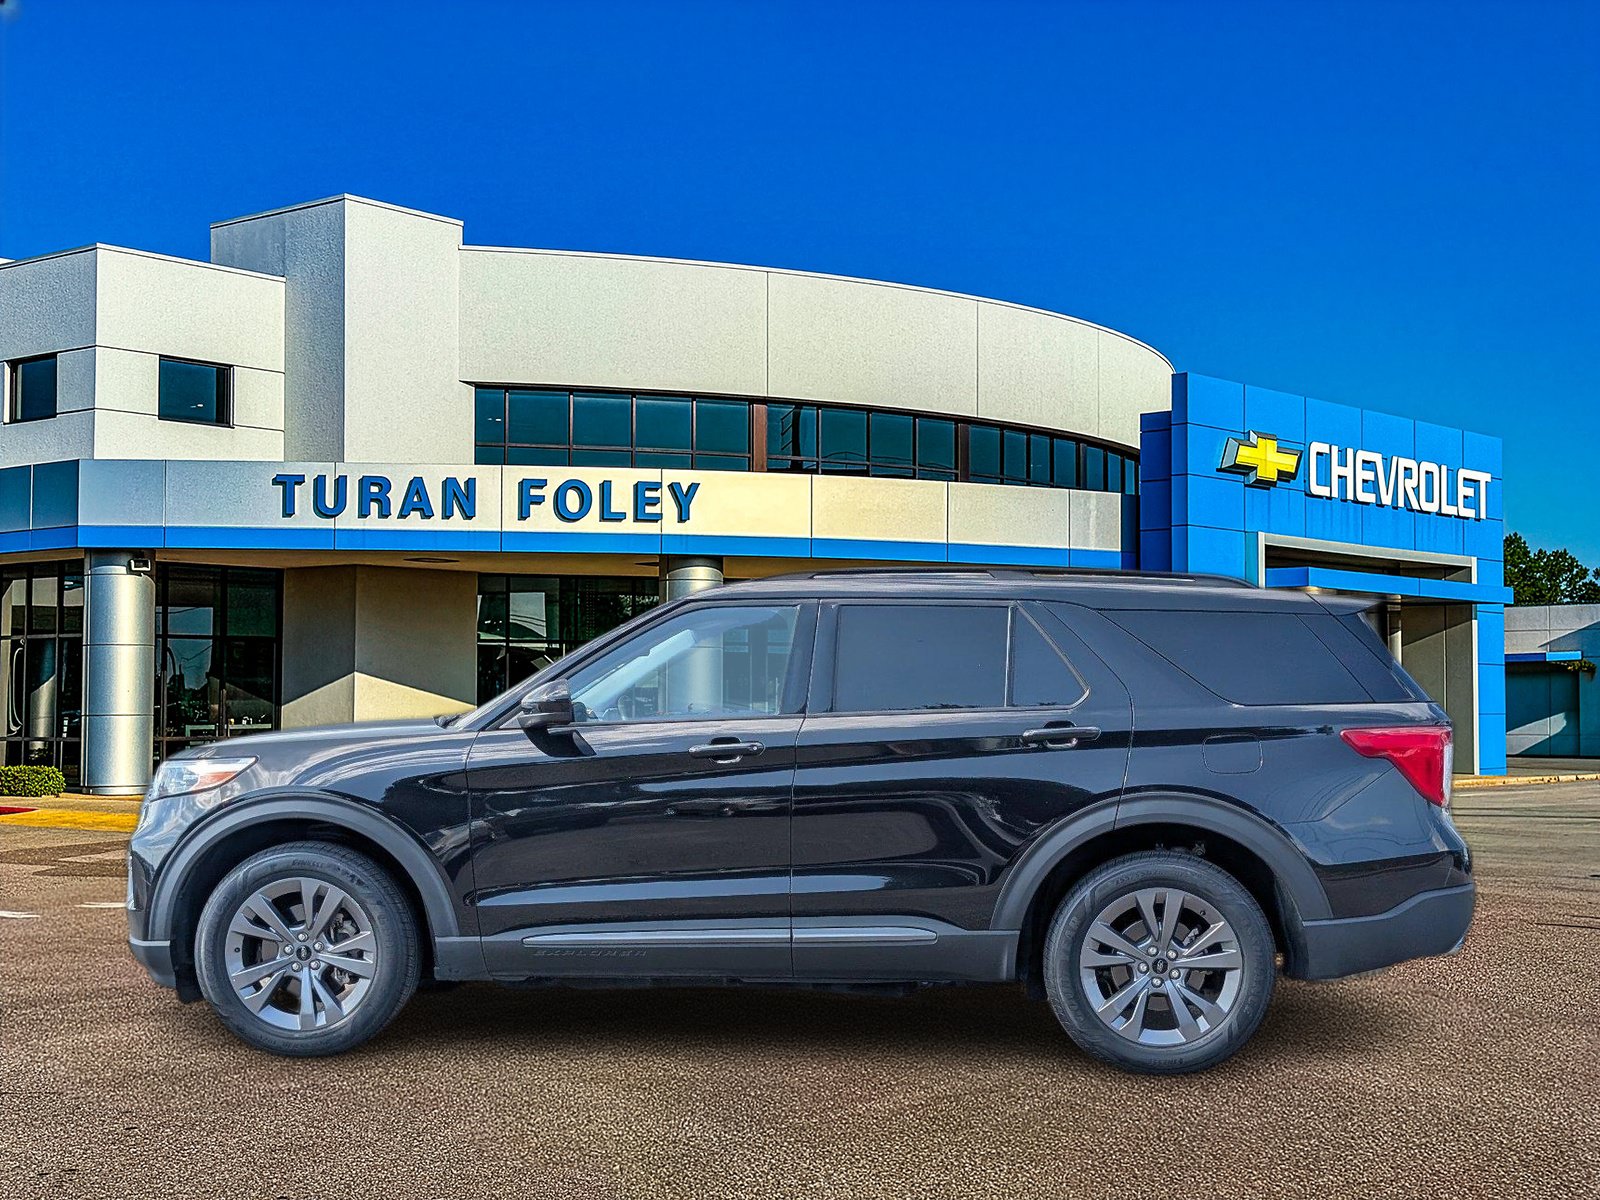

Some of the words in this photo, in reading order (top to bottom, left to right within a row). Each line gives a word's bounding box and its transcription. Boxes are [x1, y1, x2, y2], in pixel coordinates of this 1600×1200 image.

[272, 473, 476, 520] TURAN
[517, 478, 701, 523] FOLEY
[1308, 440, 1492, 520] CHEVROLET
